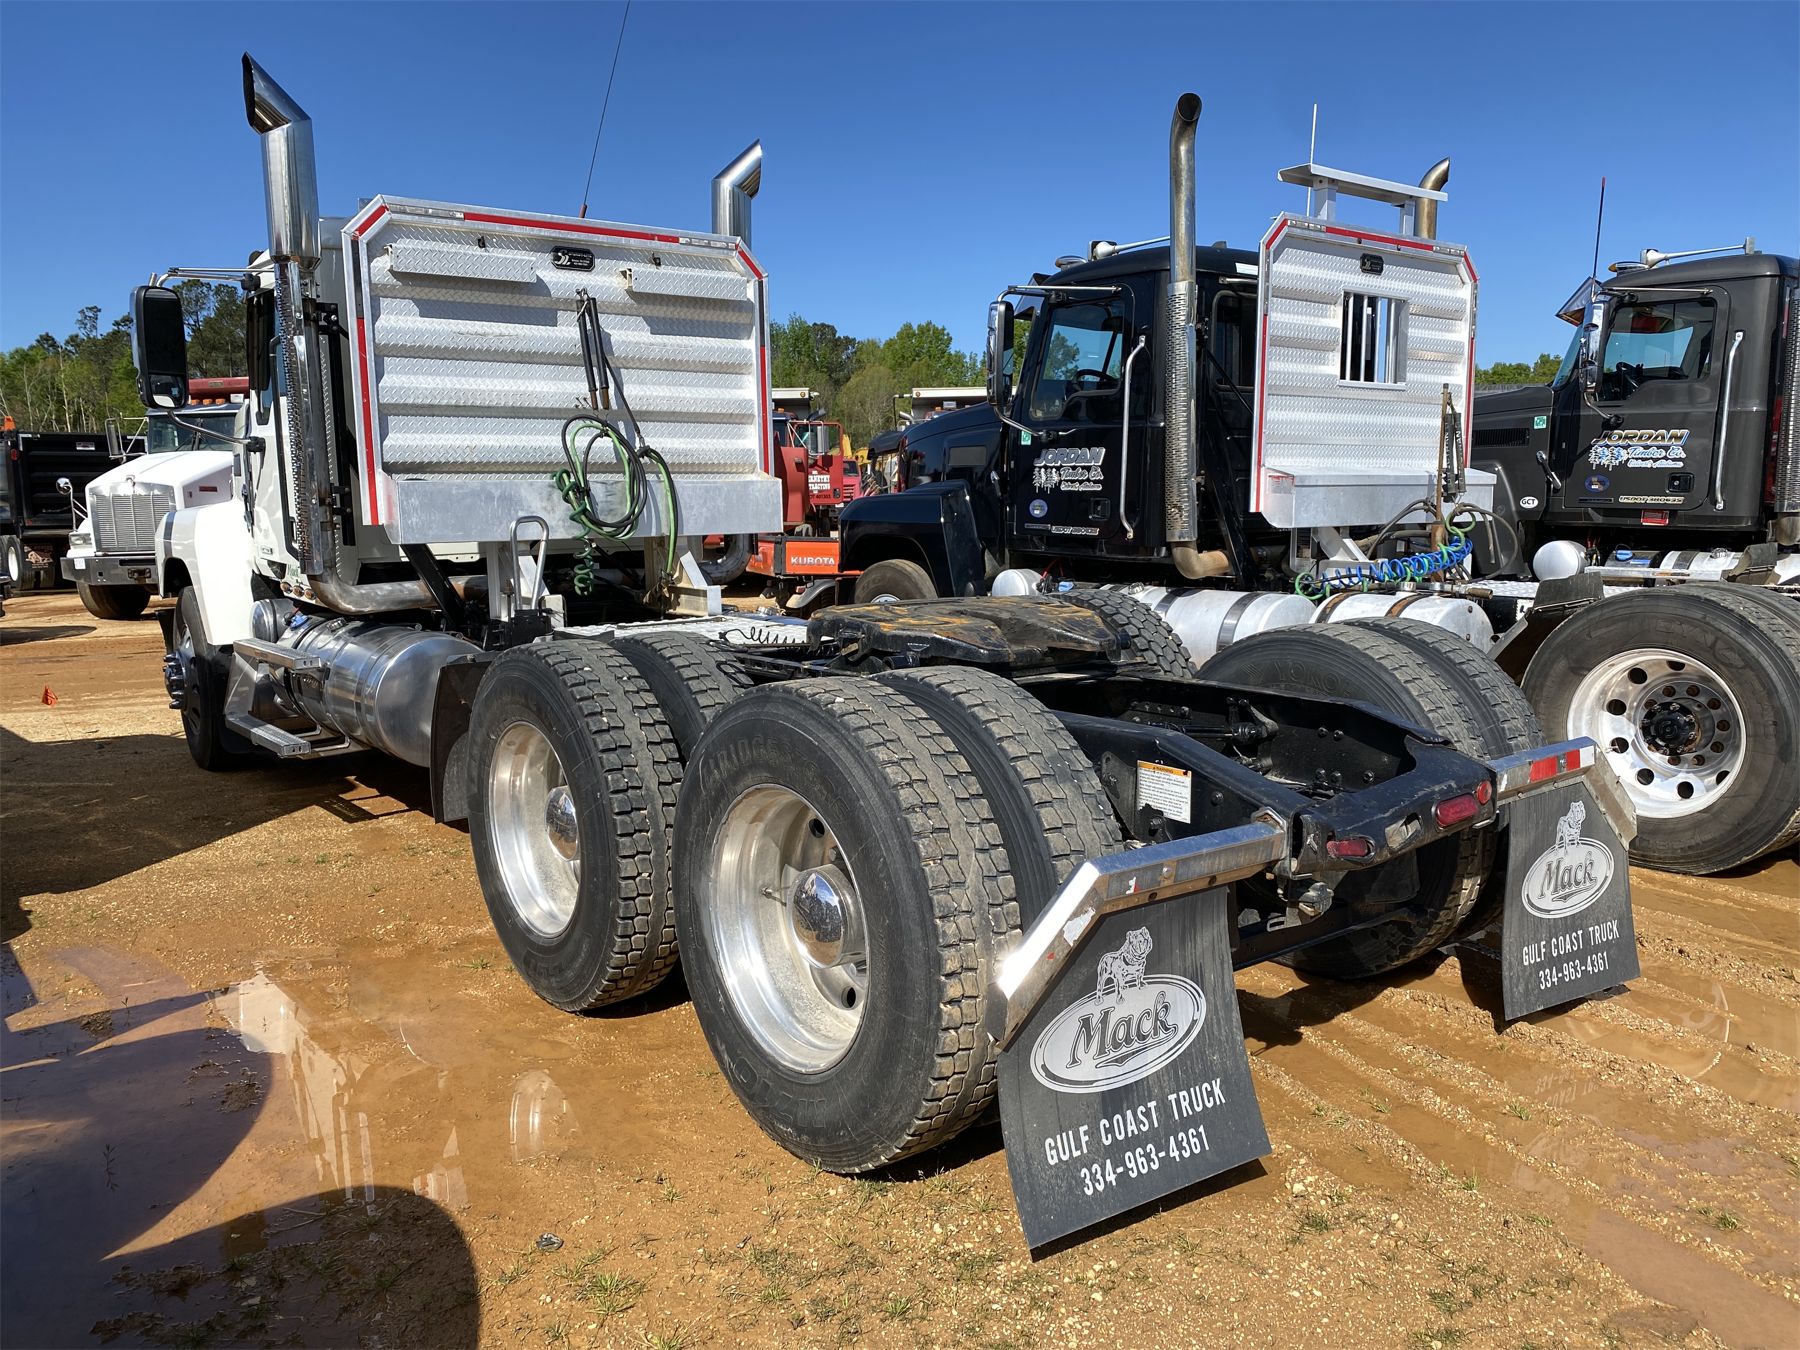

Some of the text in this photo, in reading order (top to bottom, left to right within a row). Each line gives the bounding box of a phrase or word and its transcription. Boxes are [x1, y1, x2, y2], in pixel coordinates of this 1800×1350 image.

[1033, 447, 1105, 466] JORDAN
[1591, 430, 1690, 446] JORDAN
[1628, 446, 1665, 458] Timber
[791, 556, 835, 566] KUBOTA
[1537, 851, 1598, 900] Mack
[1522, 919, 1620, 966] GULF COAST TRUCK
[1538, 951, 1610, 990] 334-963-4361
[1066, 991, 1178, 1068] Mack
[1044, 1077, 1227, 1166] GULF COAST TRUCK
[1080, 1124, 1211, 1197] 334-963-4361
